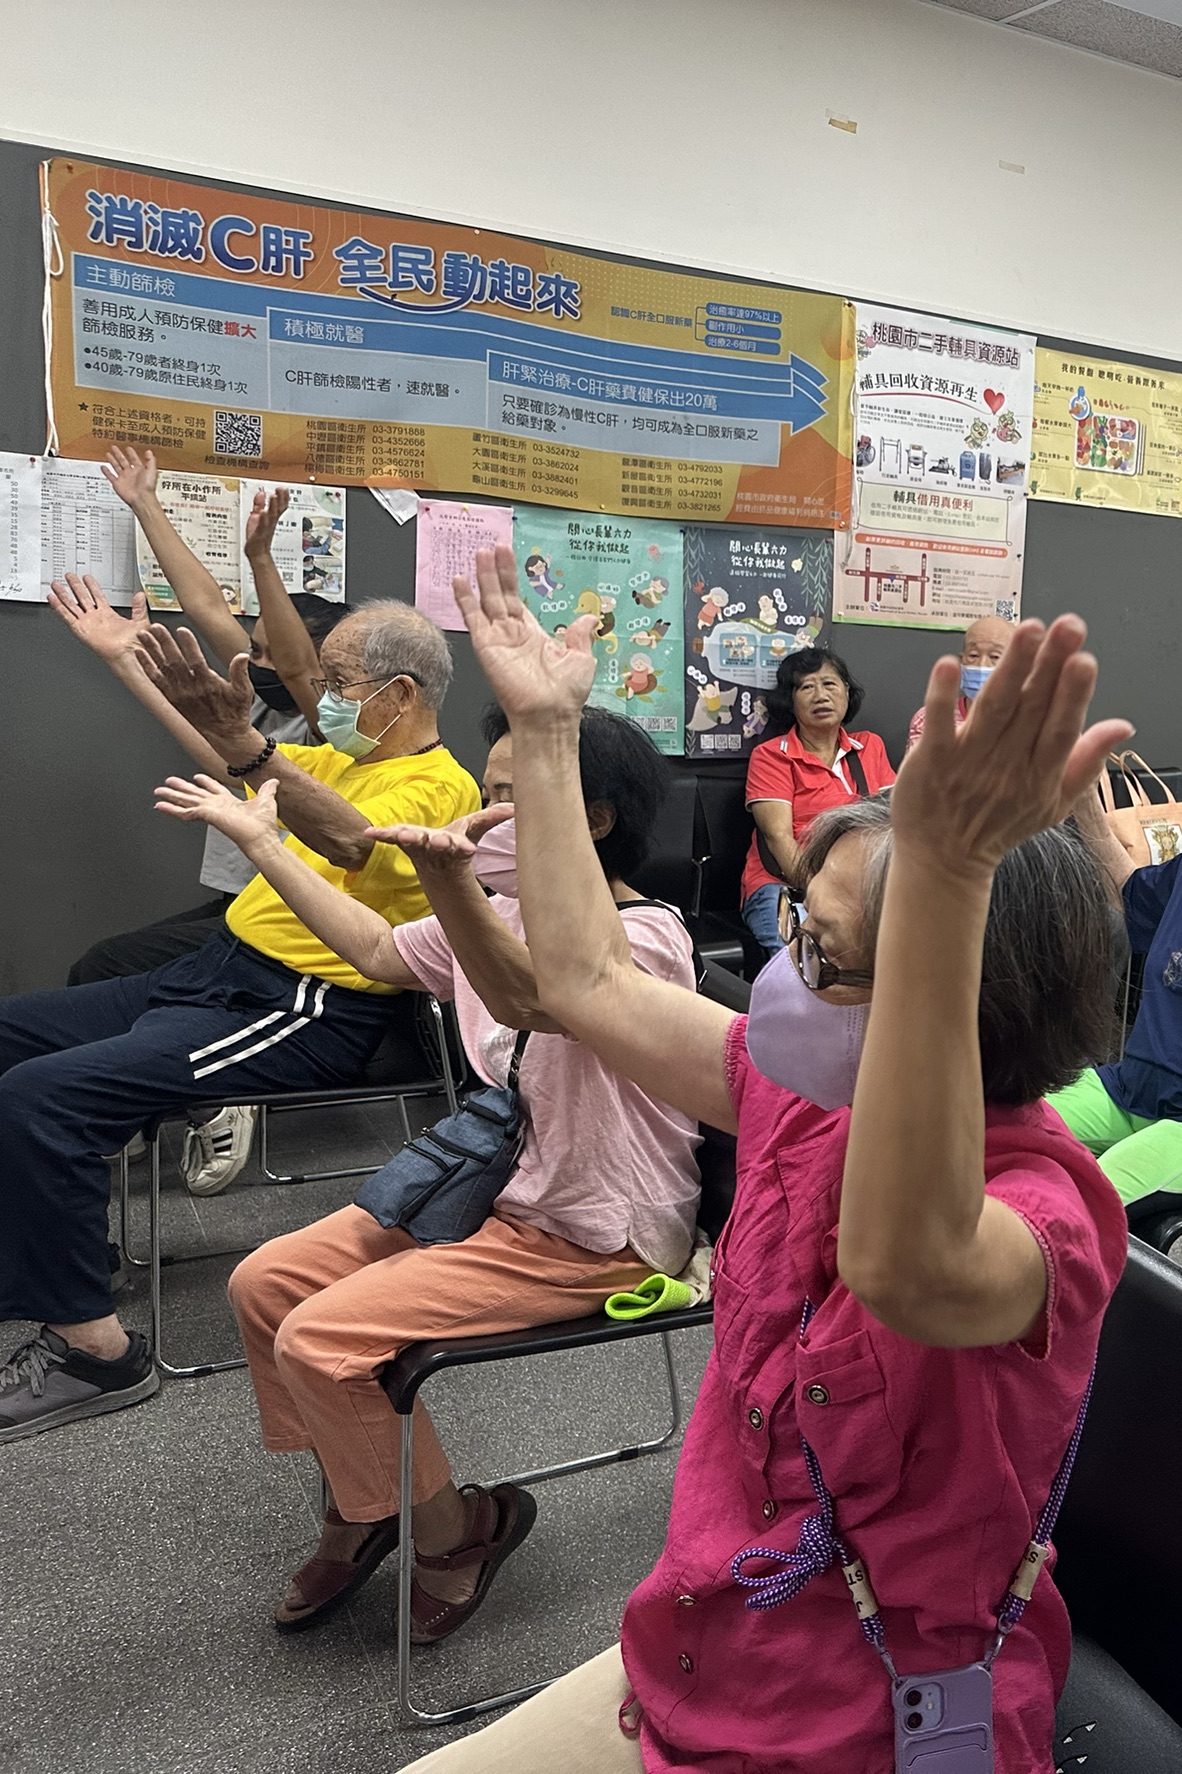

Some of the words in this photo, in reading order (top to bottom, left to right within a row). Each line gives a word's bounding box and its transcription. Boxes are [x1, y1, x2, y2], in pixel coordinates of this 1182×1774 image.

[86, 191, 315, 278] 消滅C肝
[334, 237, 582, 320] 全民動起來
[86, 264, 176, 297] 主動篩檢
[82, 298, 257, 339] 善用成人預防保健擴大
[708, 320, 745, 334] 副作用小
[82, 317, 167, 343] 篩檢服務。
[284, 318, 364, 344] 積極就醫
[708, 336, 756, 351] 治療2-6個月
[872, 321, 1020, 369] 桃園市二手輔具資源站
[502, 361, 718, 411] 肝緊治療-C肝藥費健保出20萬
[859, 373, 978, 403] 輔具回收資源再生
[532, 443, 580, 459] 03-3524732
[161, 480, 222, 495] 好所在小作所
[678, 490, 722, 500] 03-4732031
[893, 490, 973, 512] 輔具借用真便利
[567, 522, 632, 539] 關心長輩六力
[569, 539, 630, 554] 從你我做起
[729, 540, 787, 556] 關心長輩六力
[731, 555, 786, 570] 從你我做起
[848, 1569, 864, 1586] ST
